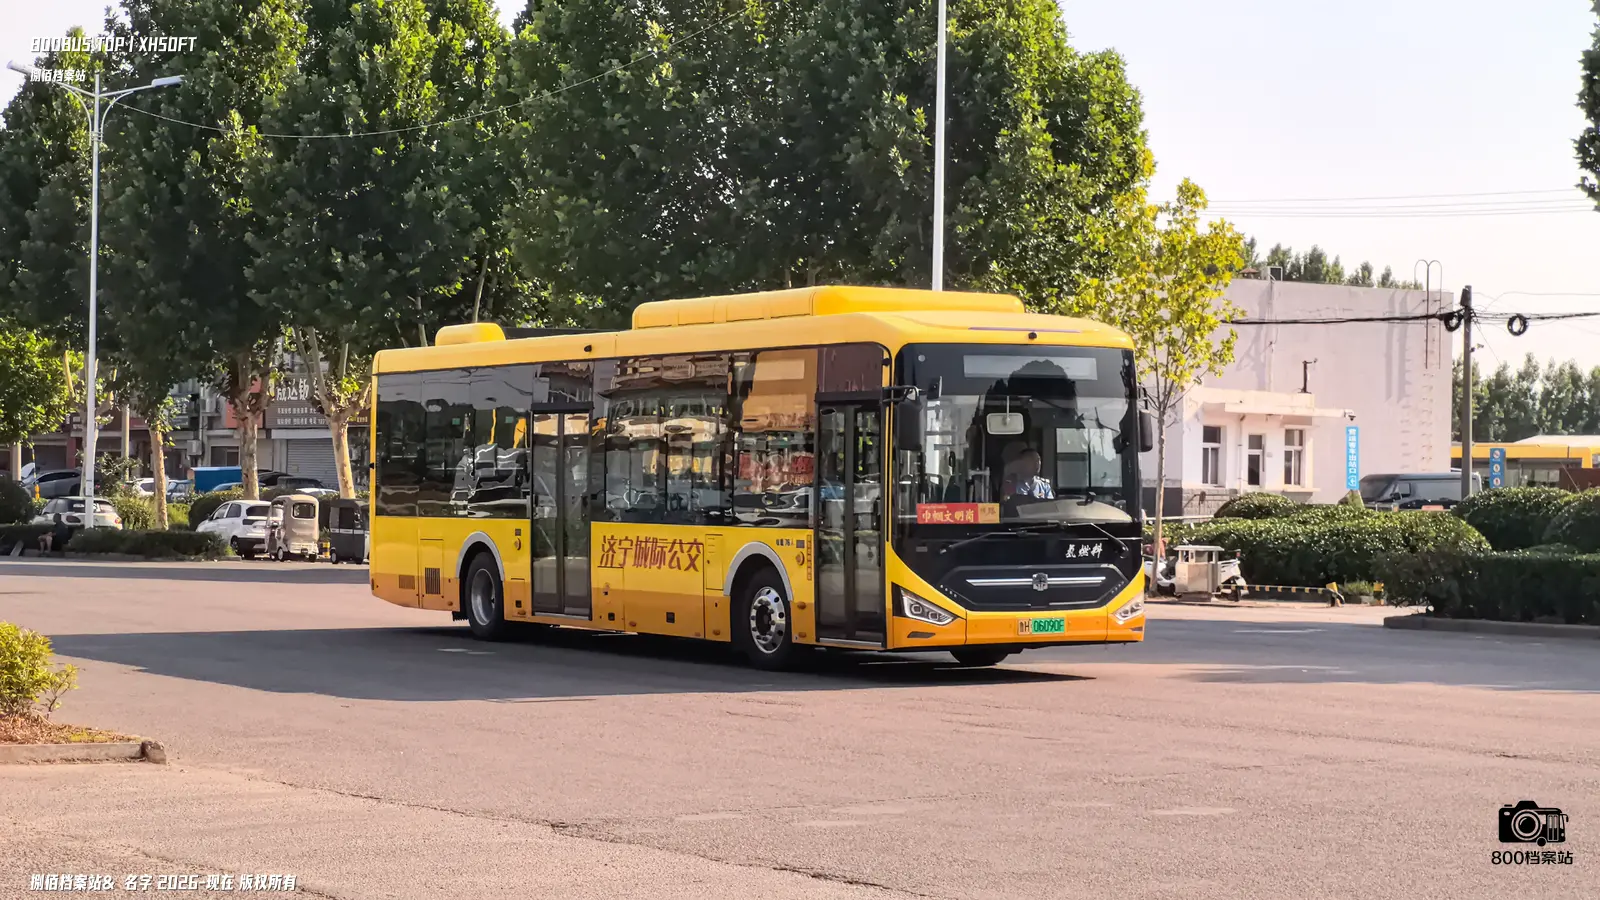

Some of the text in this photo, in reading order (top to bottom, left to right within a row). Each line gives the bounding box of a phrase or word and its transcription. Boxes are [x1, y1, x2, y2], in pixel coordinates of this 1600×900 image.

[599, 534, 703, 572] 济宁城际公交
